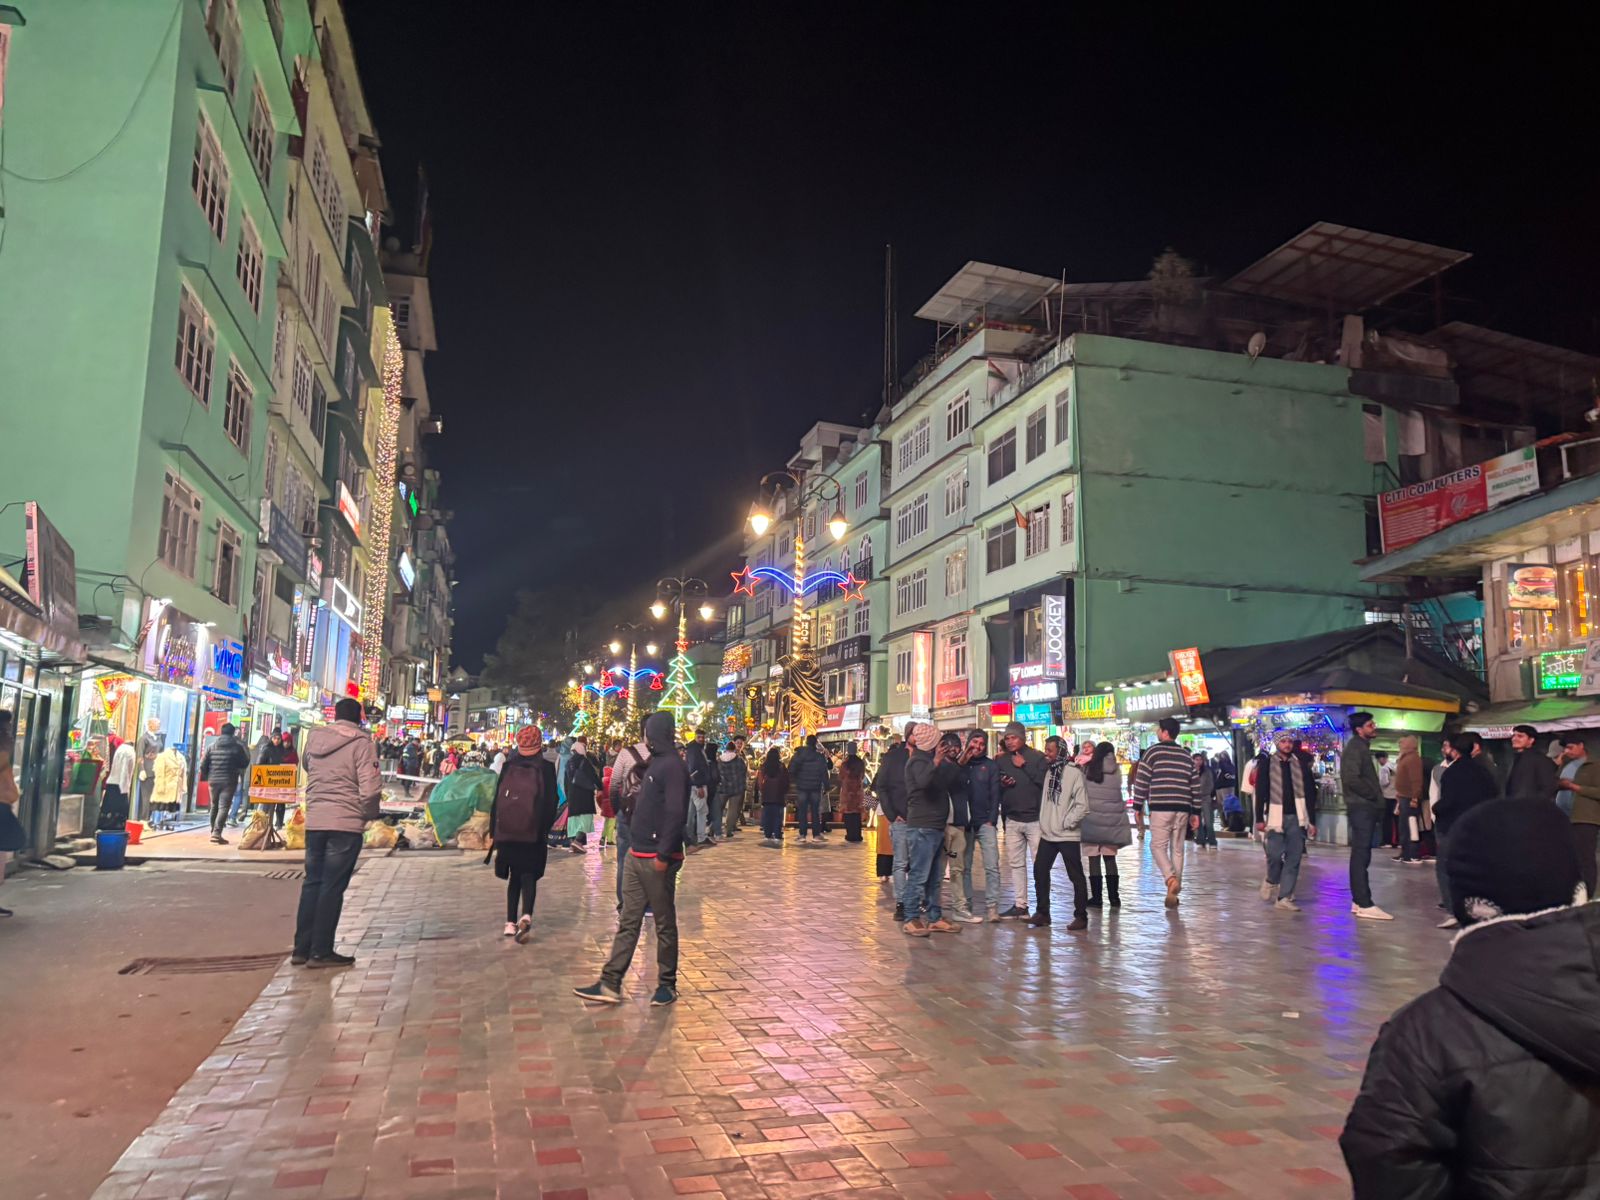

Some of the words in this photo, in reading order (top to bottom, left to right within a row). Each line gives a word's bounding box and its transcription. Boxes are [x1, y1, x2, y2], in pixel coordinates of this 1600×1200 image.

[1384, 487, 1406, 504] CITI
[1048, 596, 1062, 661] JOCKEY
[213, 639, 243, 680] vivo
[1070, 697, 1086, 712] CITI
[1087, 696, 1106, 711] GIFT
[1125, 692, 1174, 713] SAMSUNG
